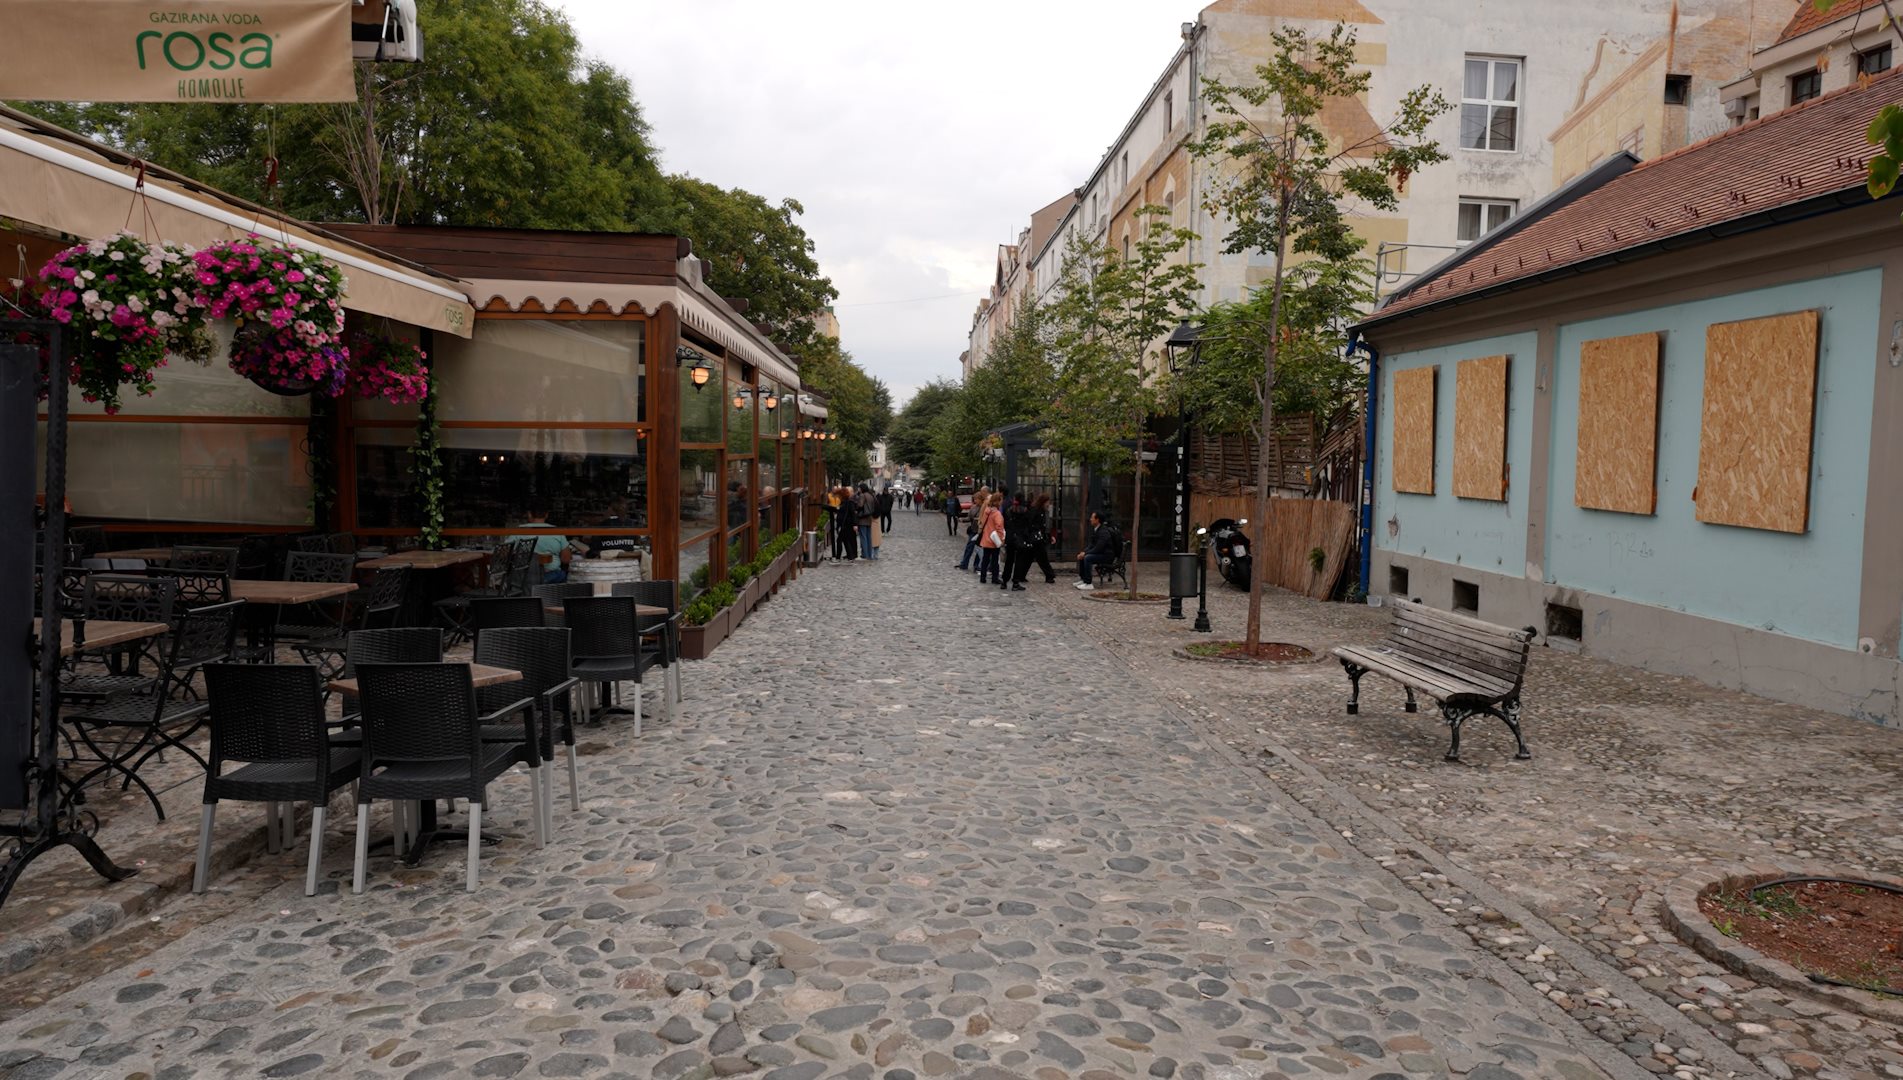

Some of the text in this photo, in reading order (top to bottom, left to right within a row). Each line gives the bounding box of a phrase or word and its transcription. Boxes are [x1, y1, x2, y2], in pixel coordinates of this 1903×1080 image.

[149, 12, 262, 25] GAZIRANA VODA
[136, 30, 273, 71] rosa
[178, 78, 246, 98] HOMOLJE
[445, 308, 463, 325] rosa
